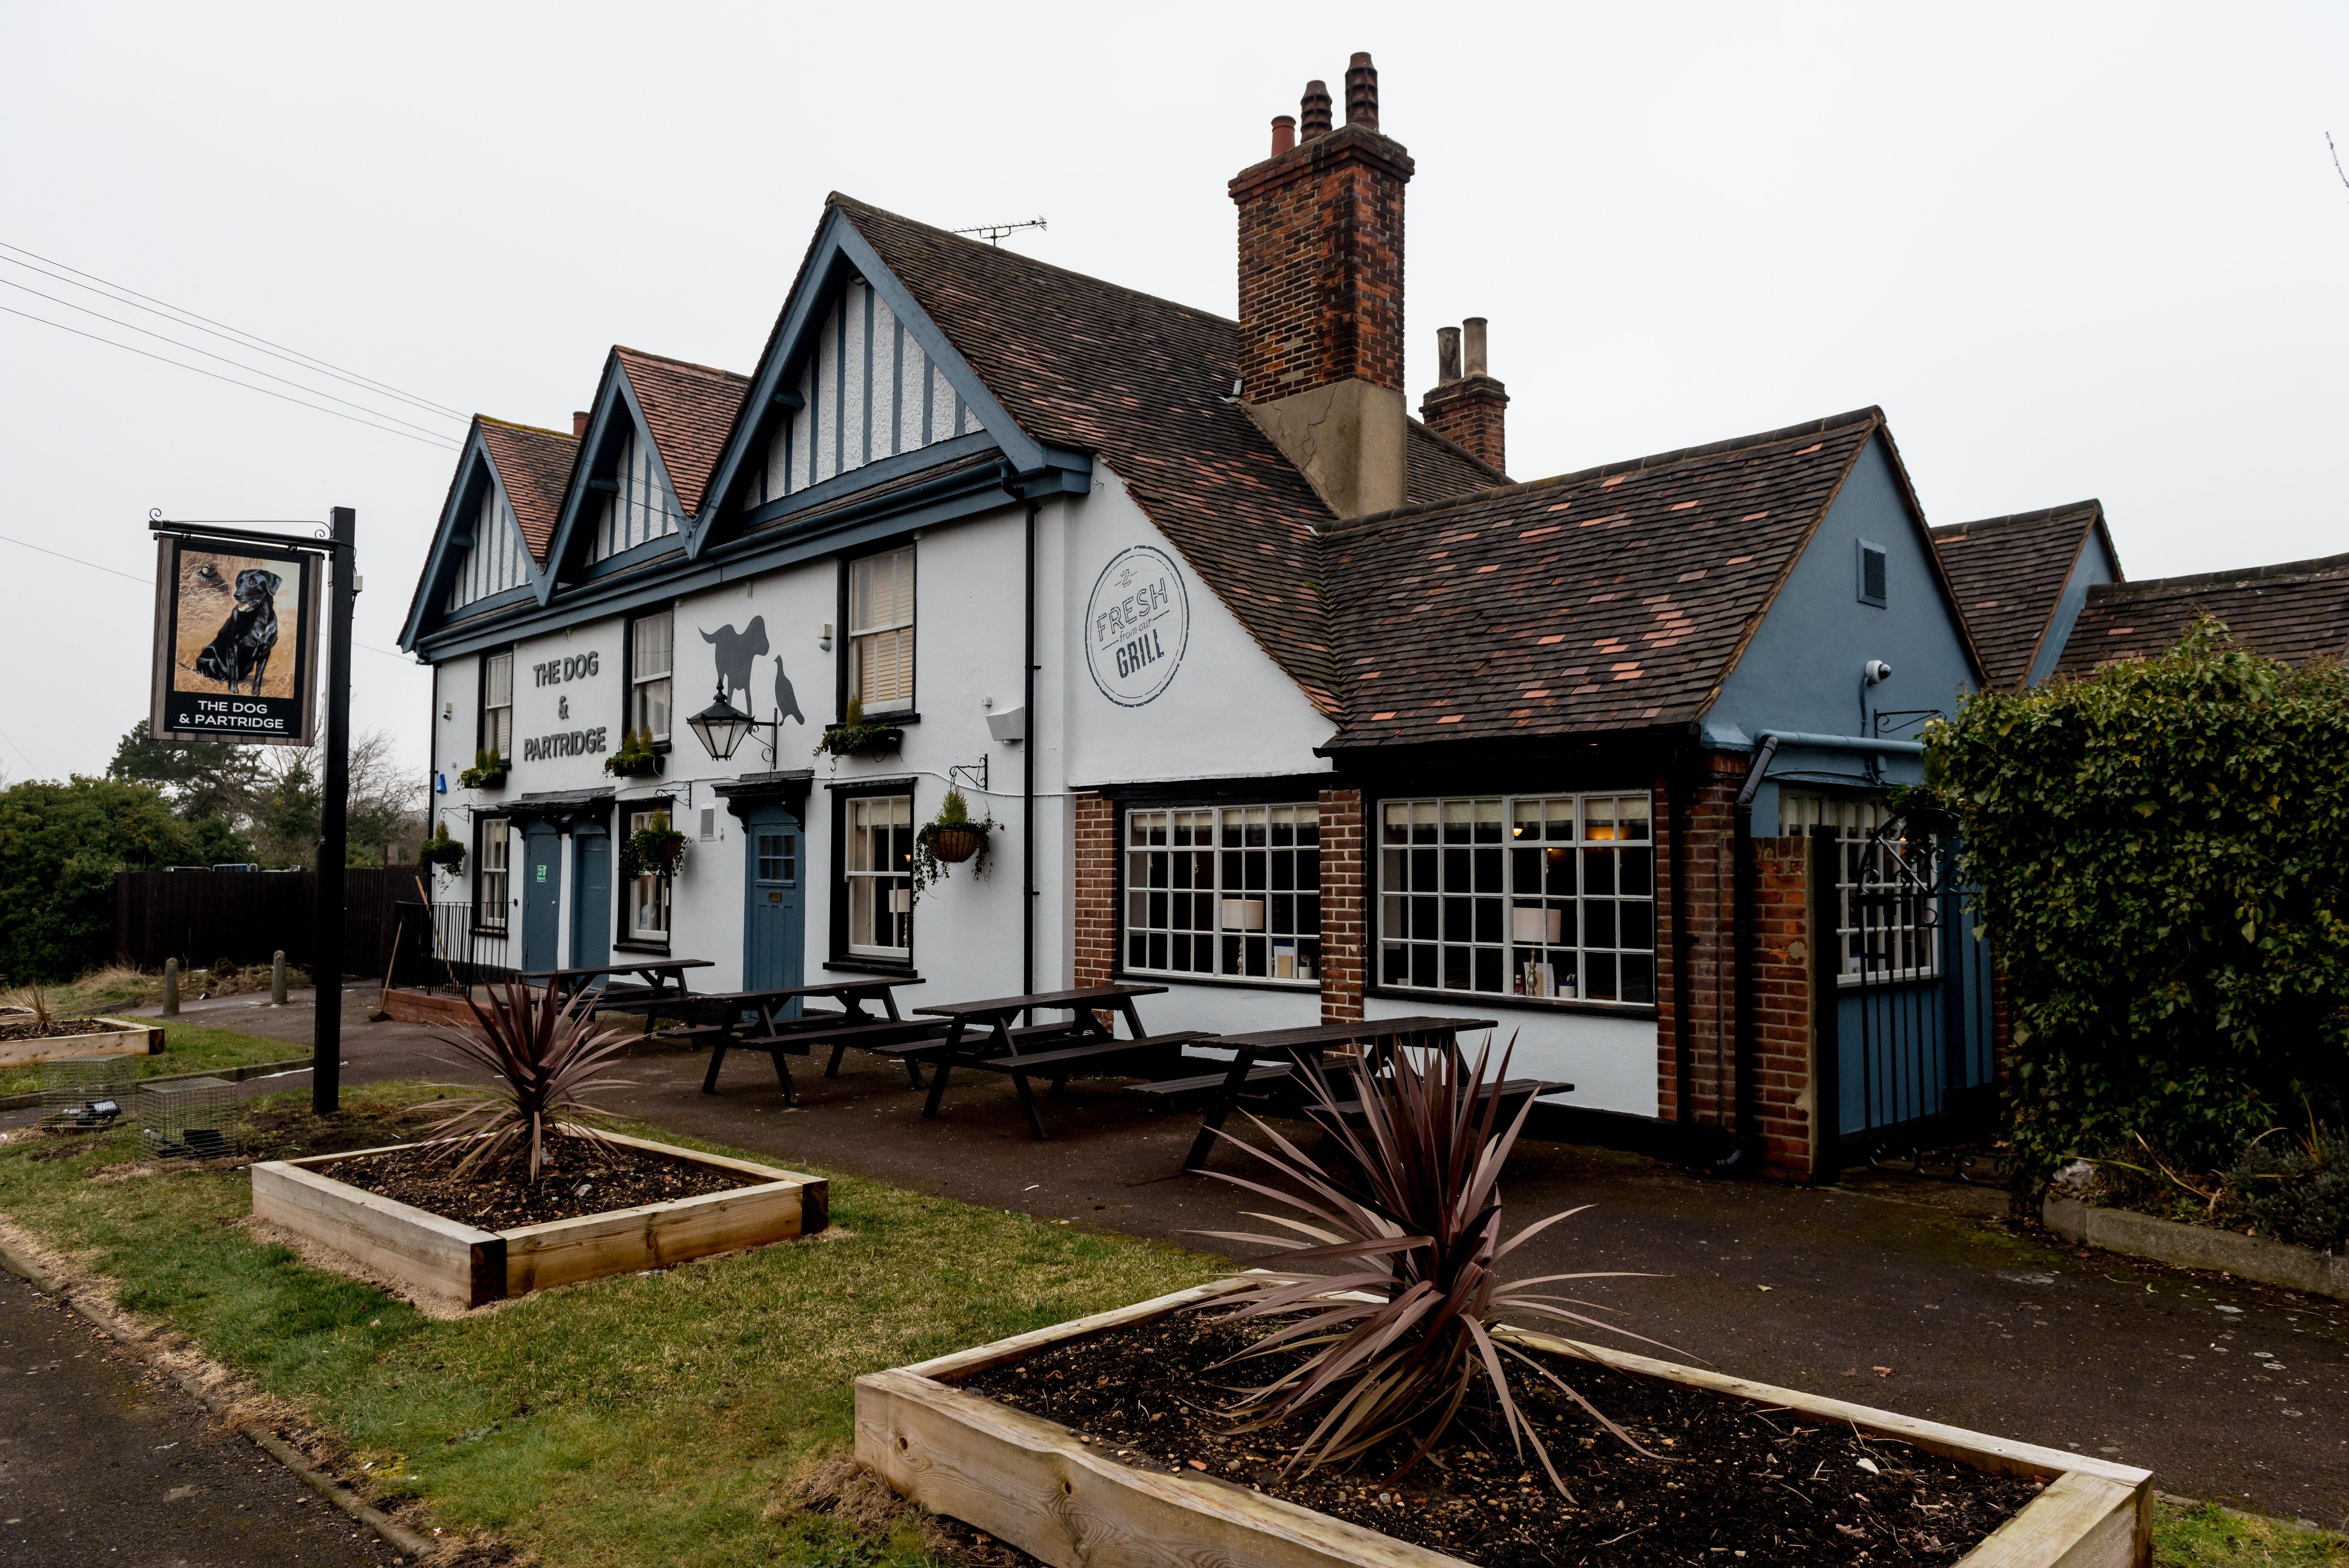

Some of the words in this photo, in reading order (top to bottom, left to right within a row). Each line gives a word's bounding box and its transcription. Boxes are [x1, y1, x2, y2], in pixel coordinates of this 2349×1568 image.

[1096, 577, 1168, 642] FRESH
[1120, 627, 1136, 642] from
[1139, 618, 1151, 631] our
[1116, 628, 1165, 679] GRILL
[533, 659, 561, 688] THE
[563, 651, 598, 682] DOG
[179, 713, 190, 724] &
[195, 714, 284, 729] PARTRIDGE
[198, 700, 228, 712] THE
[233, 702, 267, 714] DOG
[558, 695, 569, 720] &
[524, 726, 606, 762] PARTRIDGE
